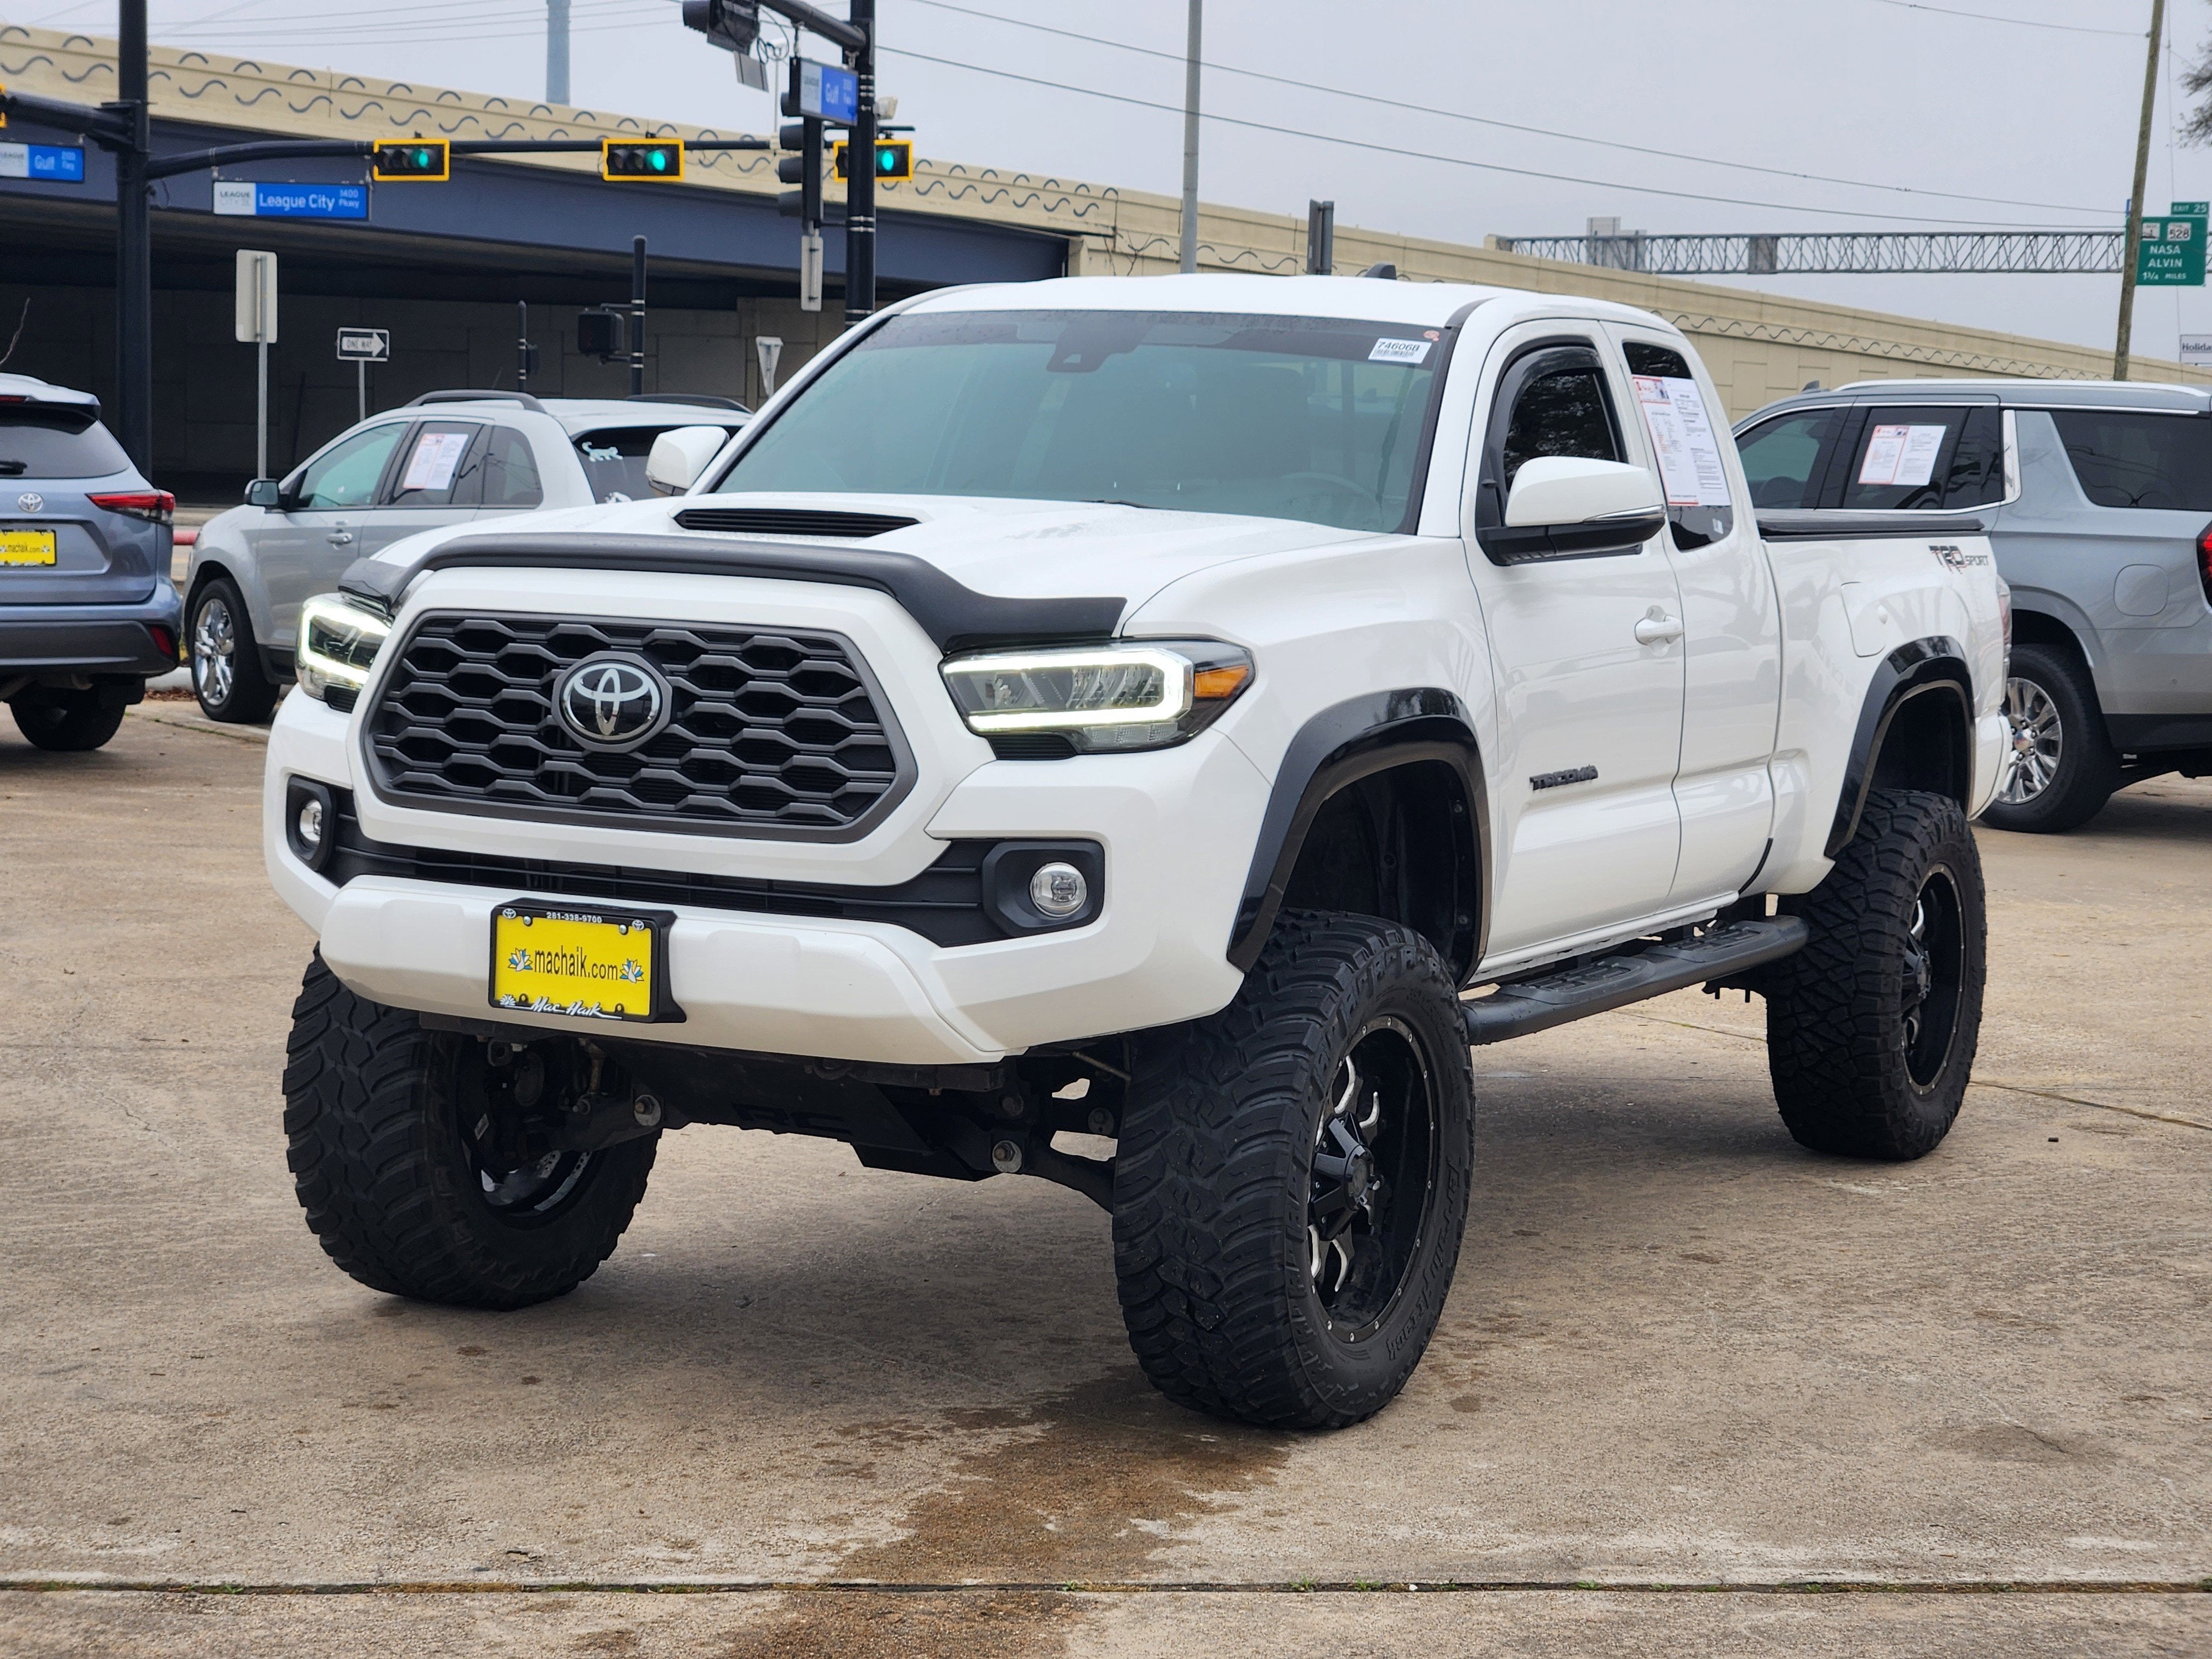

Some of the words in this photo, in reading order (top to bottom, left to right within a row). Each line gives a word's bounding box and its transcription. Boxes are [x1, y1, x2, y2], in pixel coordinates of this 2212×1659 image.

[259, 193, 306, 211] League
[309, 194, 335, 212] City
[2169, 229, 2189, 239] 528
[2149, 245, 2181, 254] NASA
[2147, 258, 2182, 267] ALVIN
[1928, 545, 1968, 574] TRD
[1965, 555, 1989, 566] SPORT
[546, 911, 603, 924] 281-338-9700
[534, 945, 618, 980] machaik.com
[530, 996, 565, 1013] Mac
[563, 1000, 608, 1018] Haik
